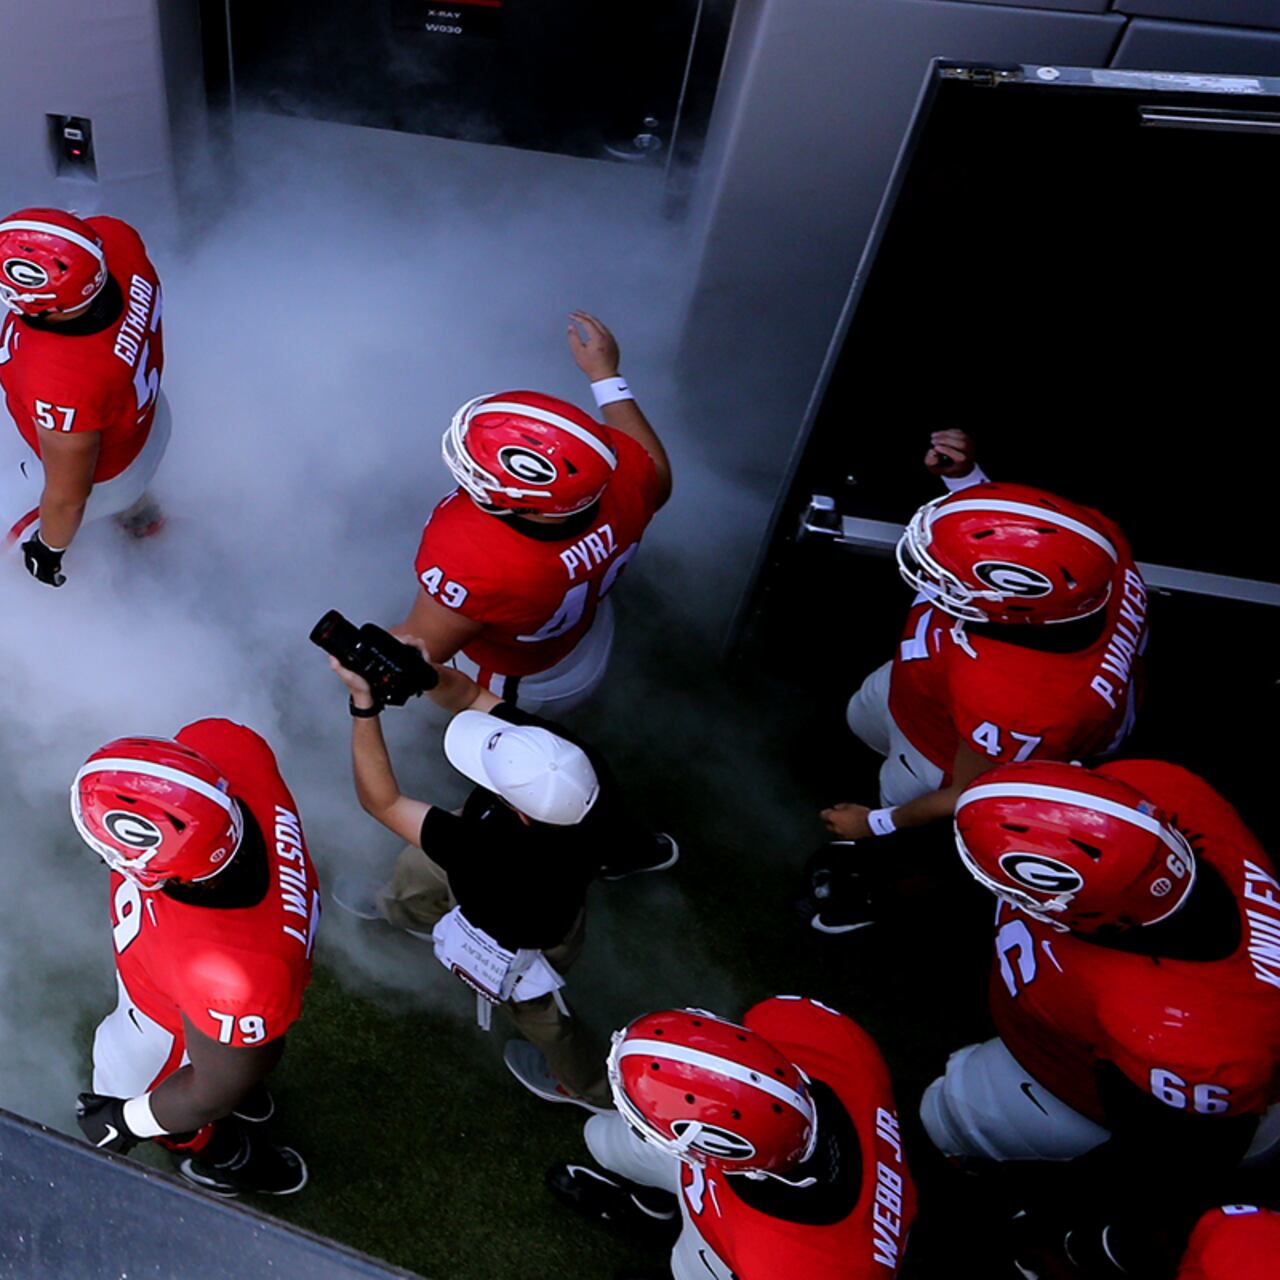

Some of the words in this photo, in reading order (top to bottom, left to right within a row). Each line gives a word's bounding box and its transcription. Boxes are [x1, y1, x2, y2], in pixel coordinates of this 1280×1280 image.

[425, 23, 462, 34] W030
[428, 9, 461, 19] X-RAY
[7, 261, 47, 287] G
[113, 274, 153, 367] GOTHARD
[35, 399, 76, 432] 57
[502, 448, 557, 483] G
[559, 524, 618, 580] PYRZ
[421, 566, 469, 608] 49
[980, 563, 1052, 597] G
[1101, 568, 1148, 683] WALKER
[972, 721, 1042, 762] 47
[108, 813, 161, 847] G
[274, 804, 308, 919] WILSON
[1006, 856, 1081, 892] G
[208, 1009, 266, 1045] 79
[1150, 1067, 1230, 1114] 66
[872, 1161, 903, 1269] WEBB
